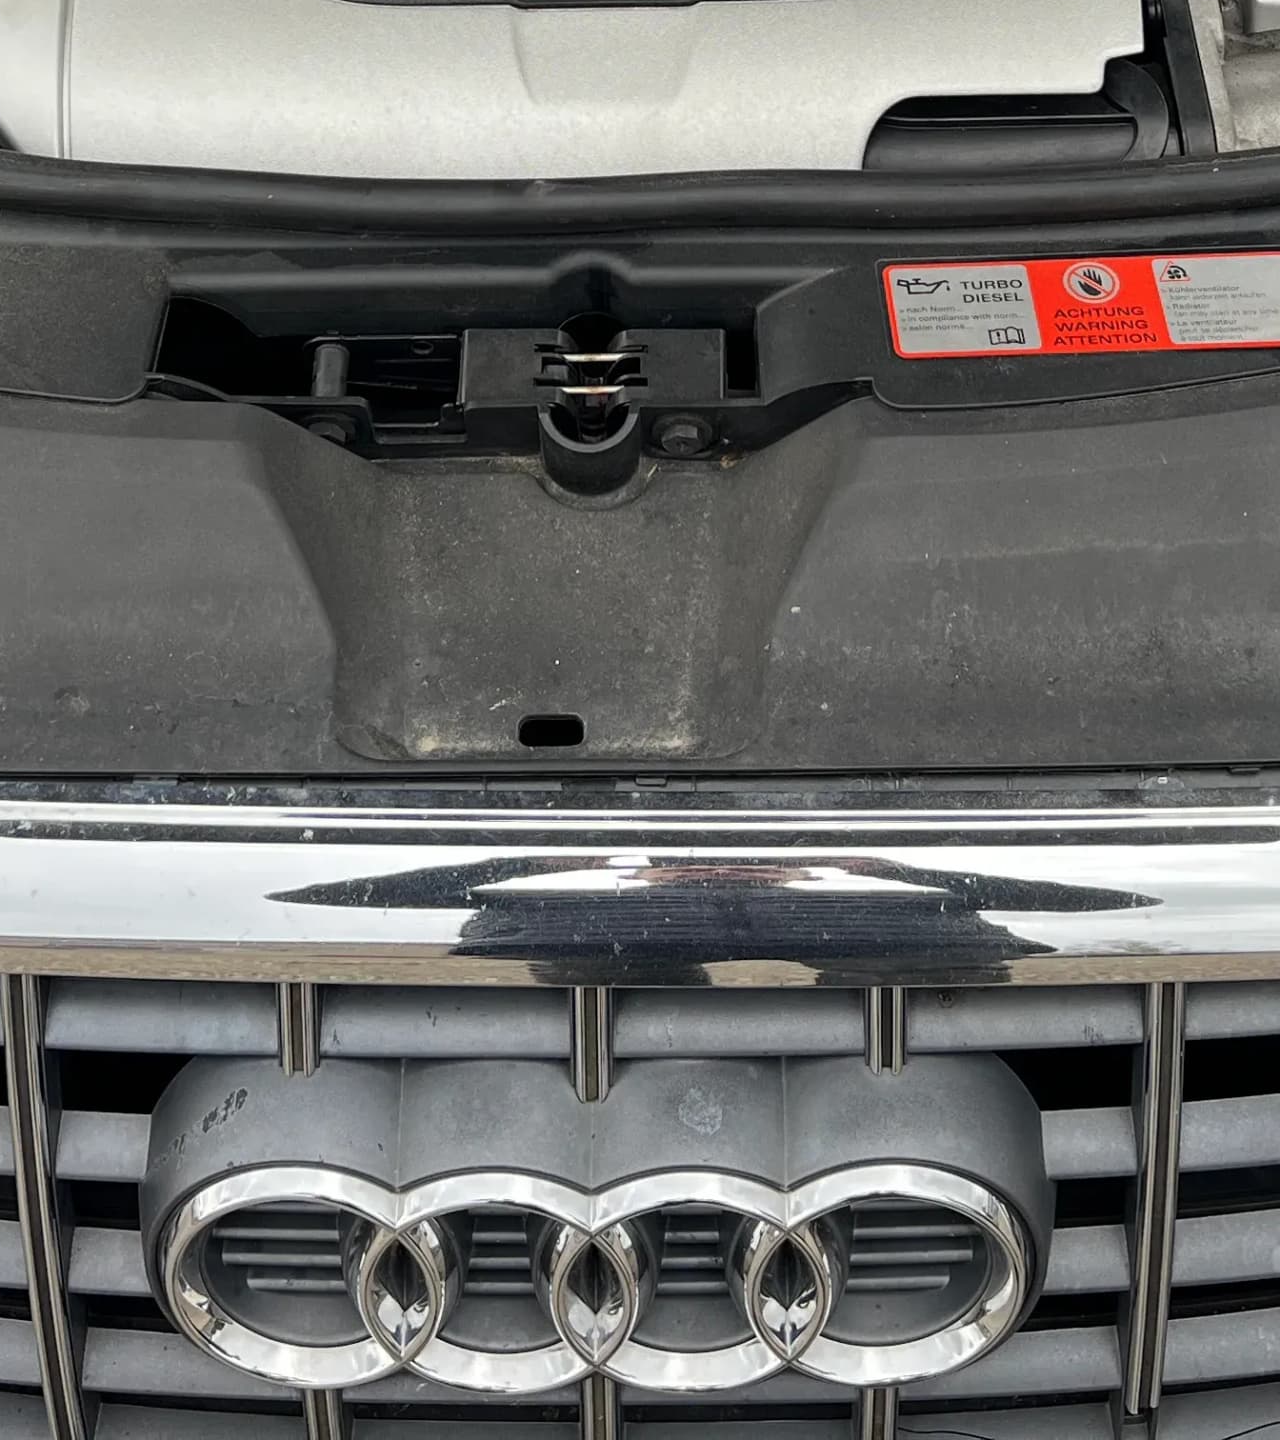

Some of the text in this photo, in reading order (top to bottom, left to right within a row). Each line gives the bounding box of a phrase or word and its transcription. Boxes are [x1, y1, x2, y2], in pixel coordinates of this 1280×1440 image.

[959, 279, 1023, 291] TURBO
[962, 292, 1025, 304] DIESEL
[971, 313, 991, 321] with
[1053, 305, 1145, 320] ACHTUNG
[1054, 318, 1149, 333] WARNING
[1052, 332, 1158, 348] ATTENTION
